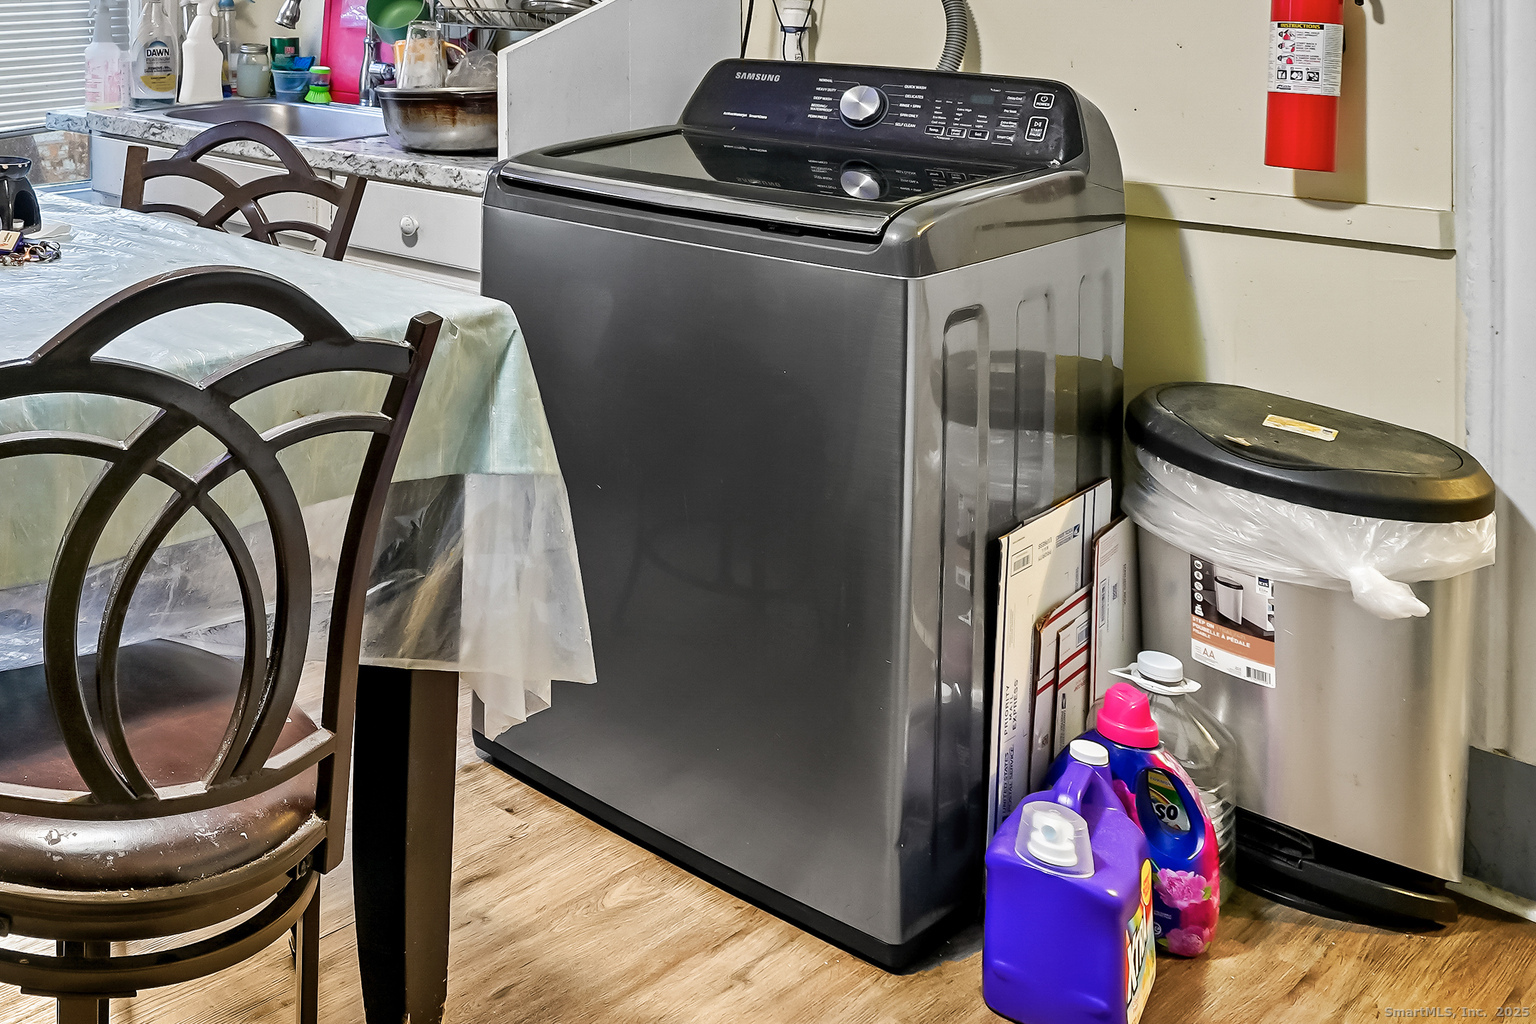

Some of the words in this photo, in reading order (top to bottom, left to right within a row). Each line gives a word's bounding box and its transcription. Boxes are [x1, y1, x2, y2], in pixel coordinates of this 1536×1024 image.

[147, 49, 170, 57] DAWN
[735, 71, 781, 82] SAMSUNG
[1203, 648, 1215, 659] AA
